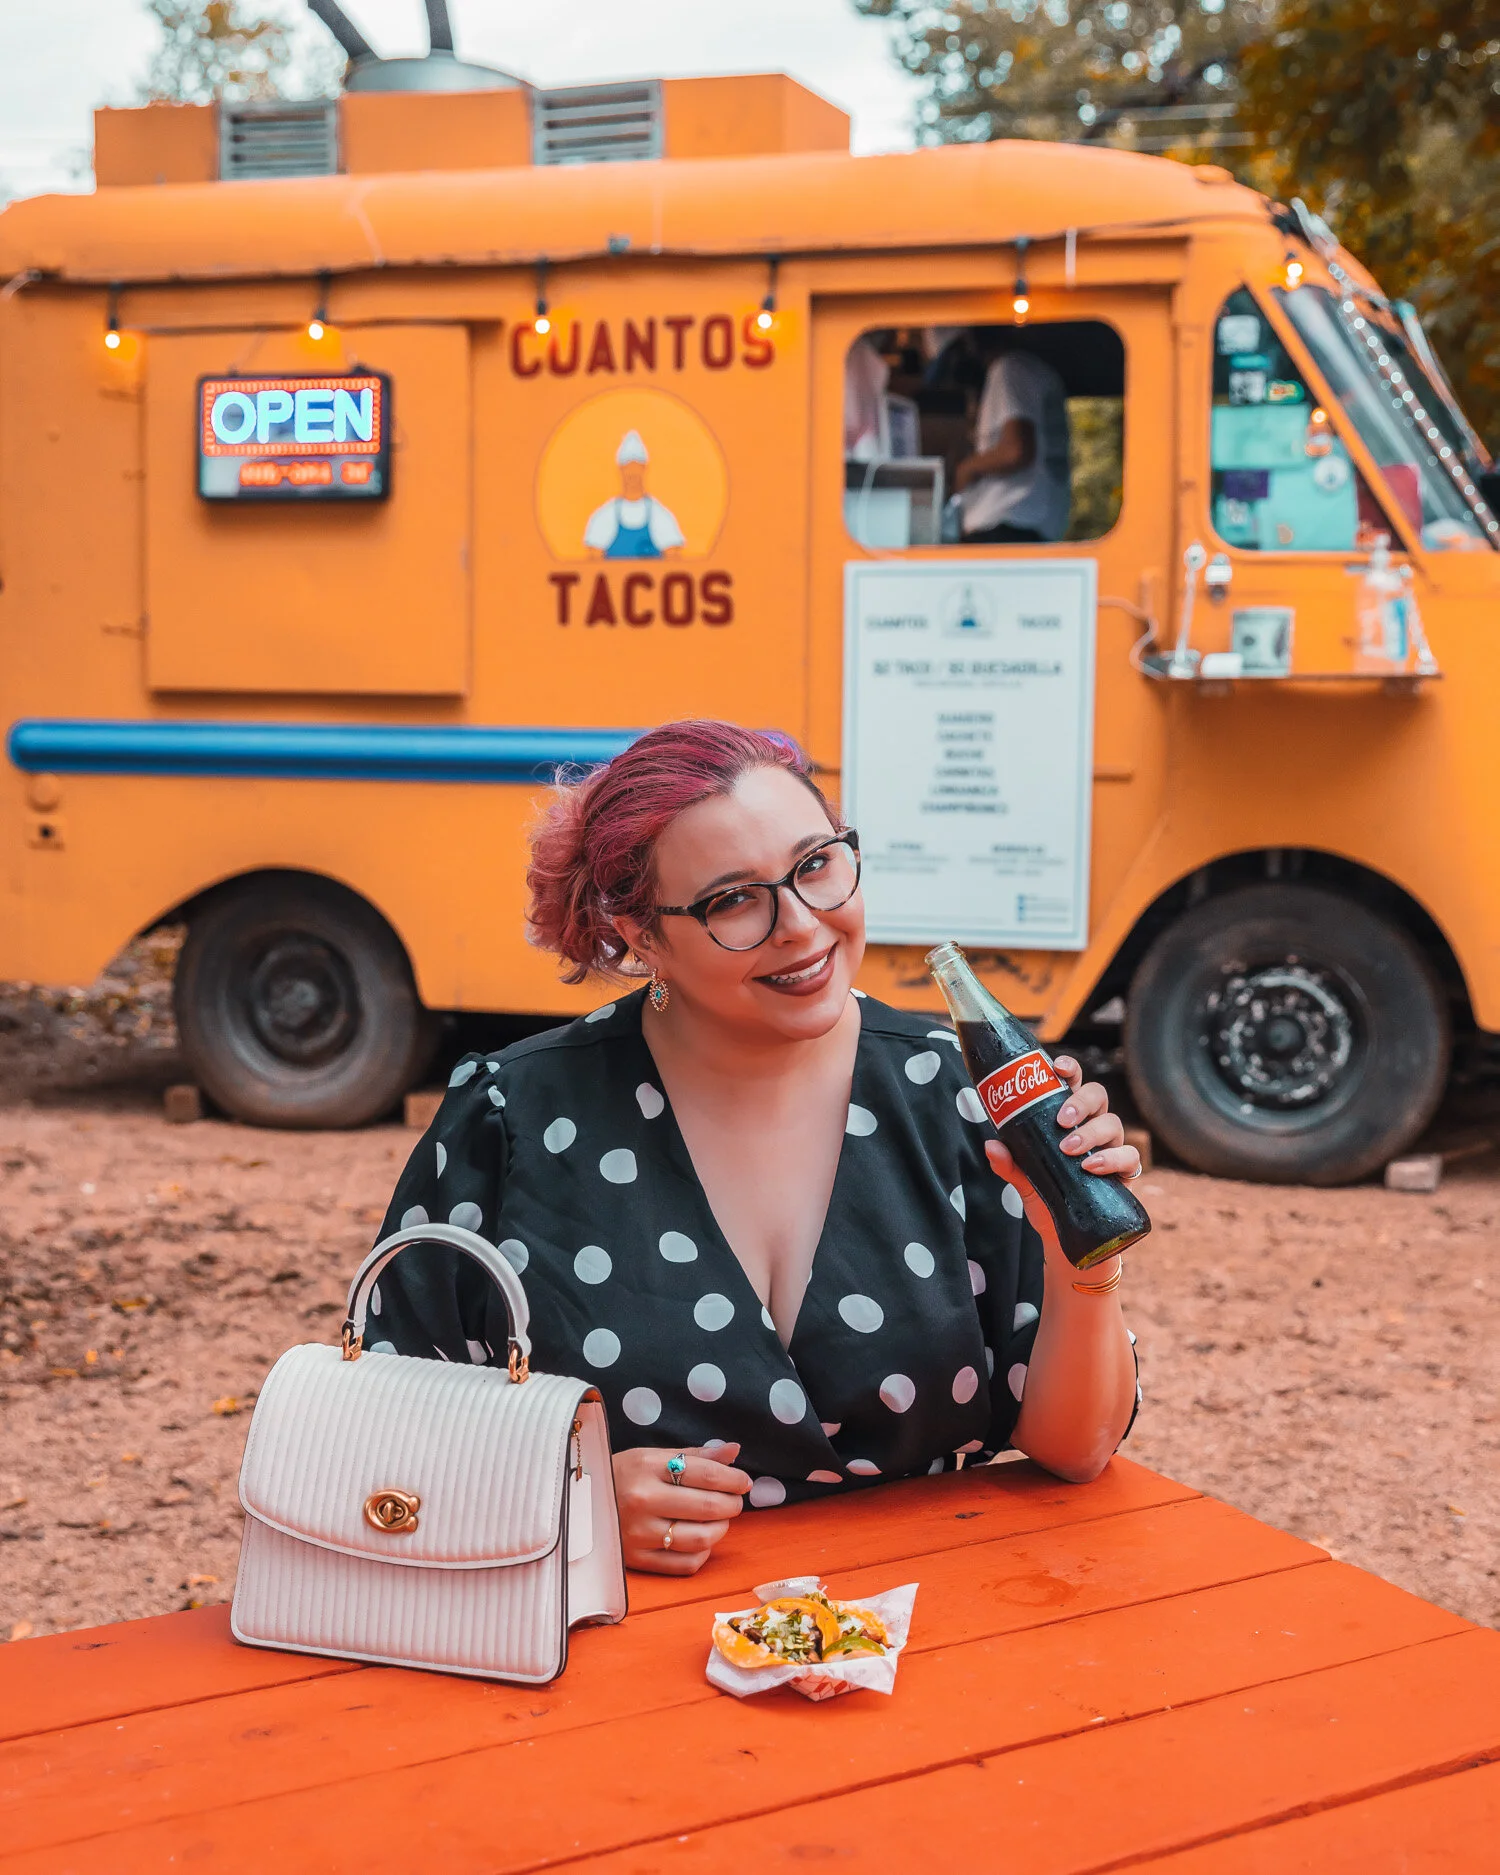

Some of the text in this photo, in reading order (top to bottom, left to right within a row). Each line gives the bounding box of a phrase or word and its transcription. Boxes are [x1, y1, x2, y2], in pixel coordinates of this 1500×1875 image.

[509, 313, 776, 378] CUANTOS
[211, 388, 373, 444] OPEN
[548, 570, 734, 628] TACOS
[988, 1059, 1048, 1112] Coca-Cola
